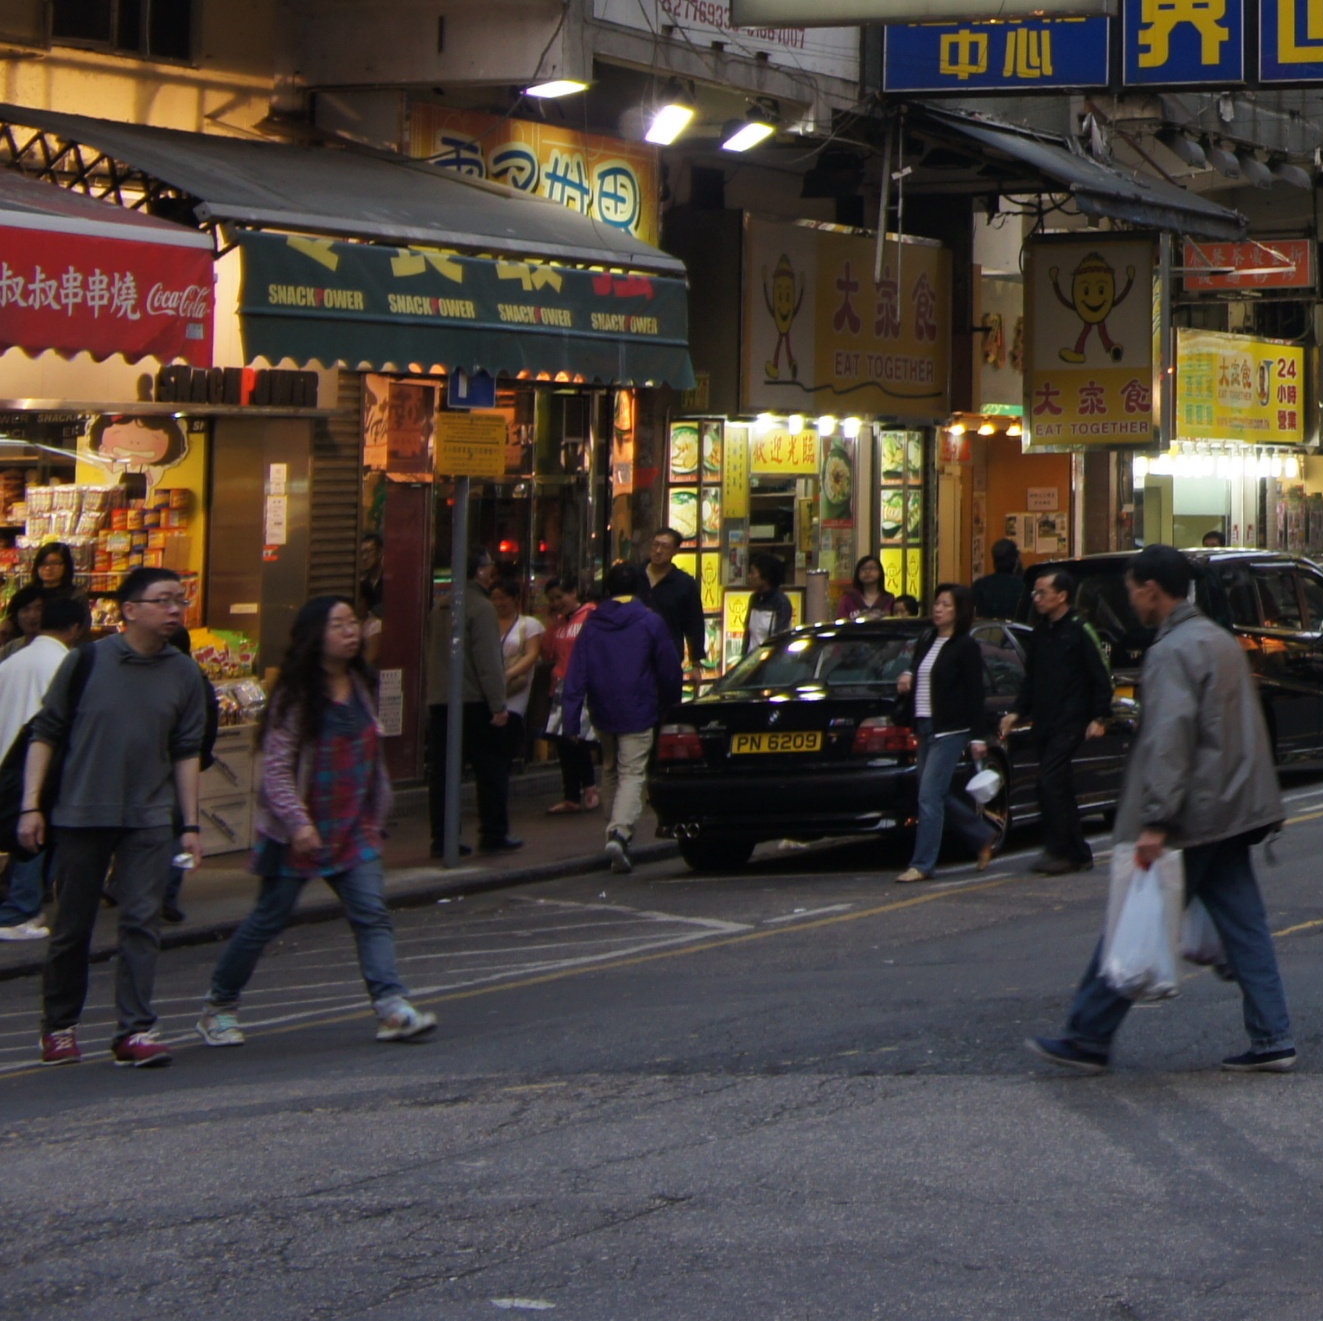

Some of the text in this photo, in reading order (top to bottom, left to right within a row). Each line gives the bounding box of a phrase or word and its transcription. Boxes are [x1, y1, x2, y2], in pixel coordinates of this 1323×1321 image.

[939, 29, 1054, 79] 中心
[268, 283, 364, 311] SNACKPOWER
[388, 293, 476, 319] SNACKPOWER
[833, 260, 937, 342] 大家食
[498, 302, 572, 328] SNACKPOWER
[591, 311, 659, 335] SNACKPOWER
[835, 349, 934, 382] EAT TOGETHER
[1277, 357, 1297, 379] 24
[1032, 379, 1152, 417] 大家食
[1035, 421, 1149, 436] EAT TOGETHER
[737, 733, 817, 751] PN 6209
